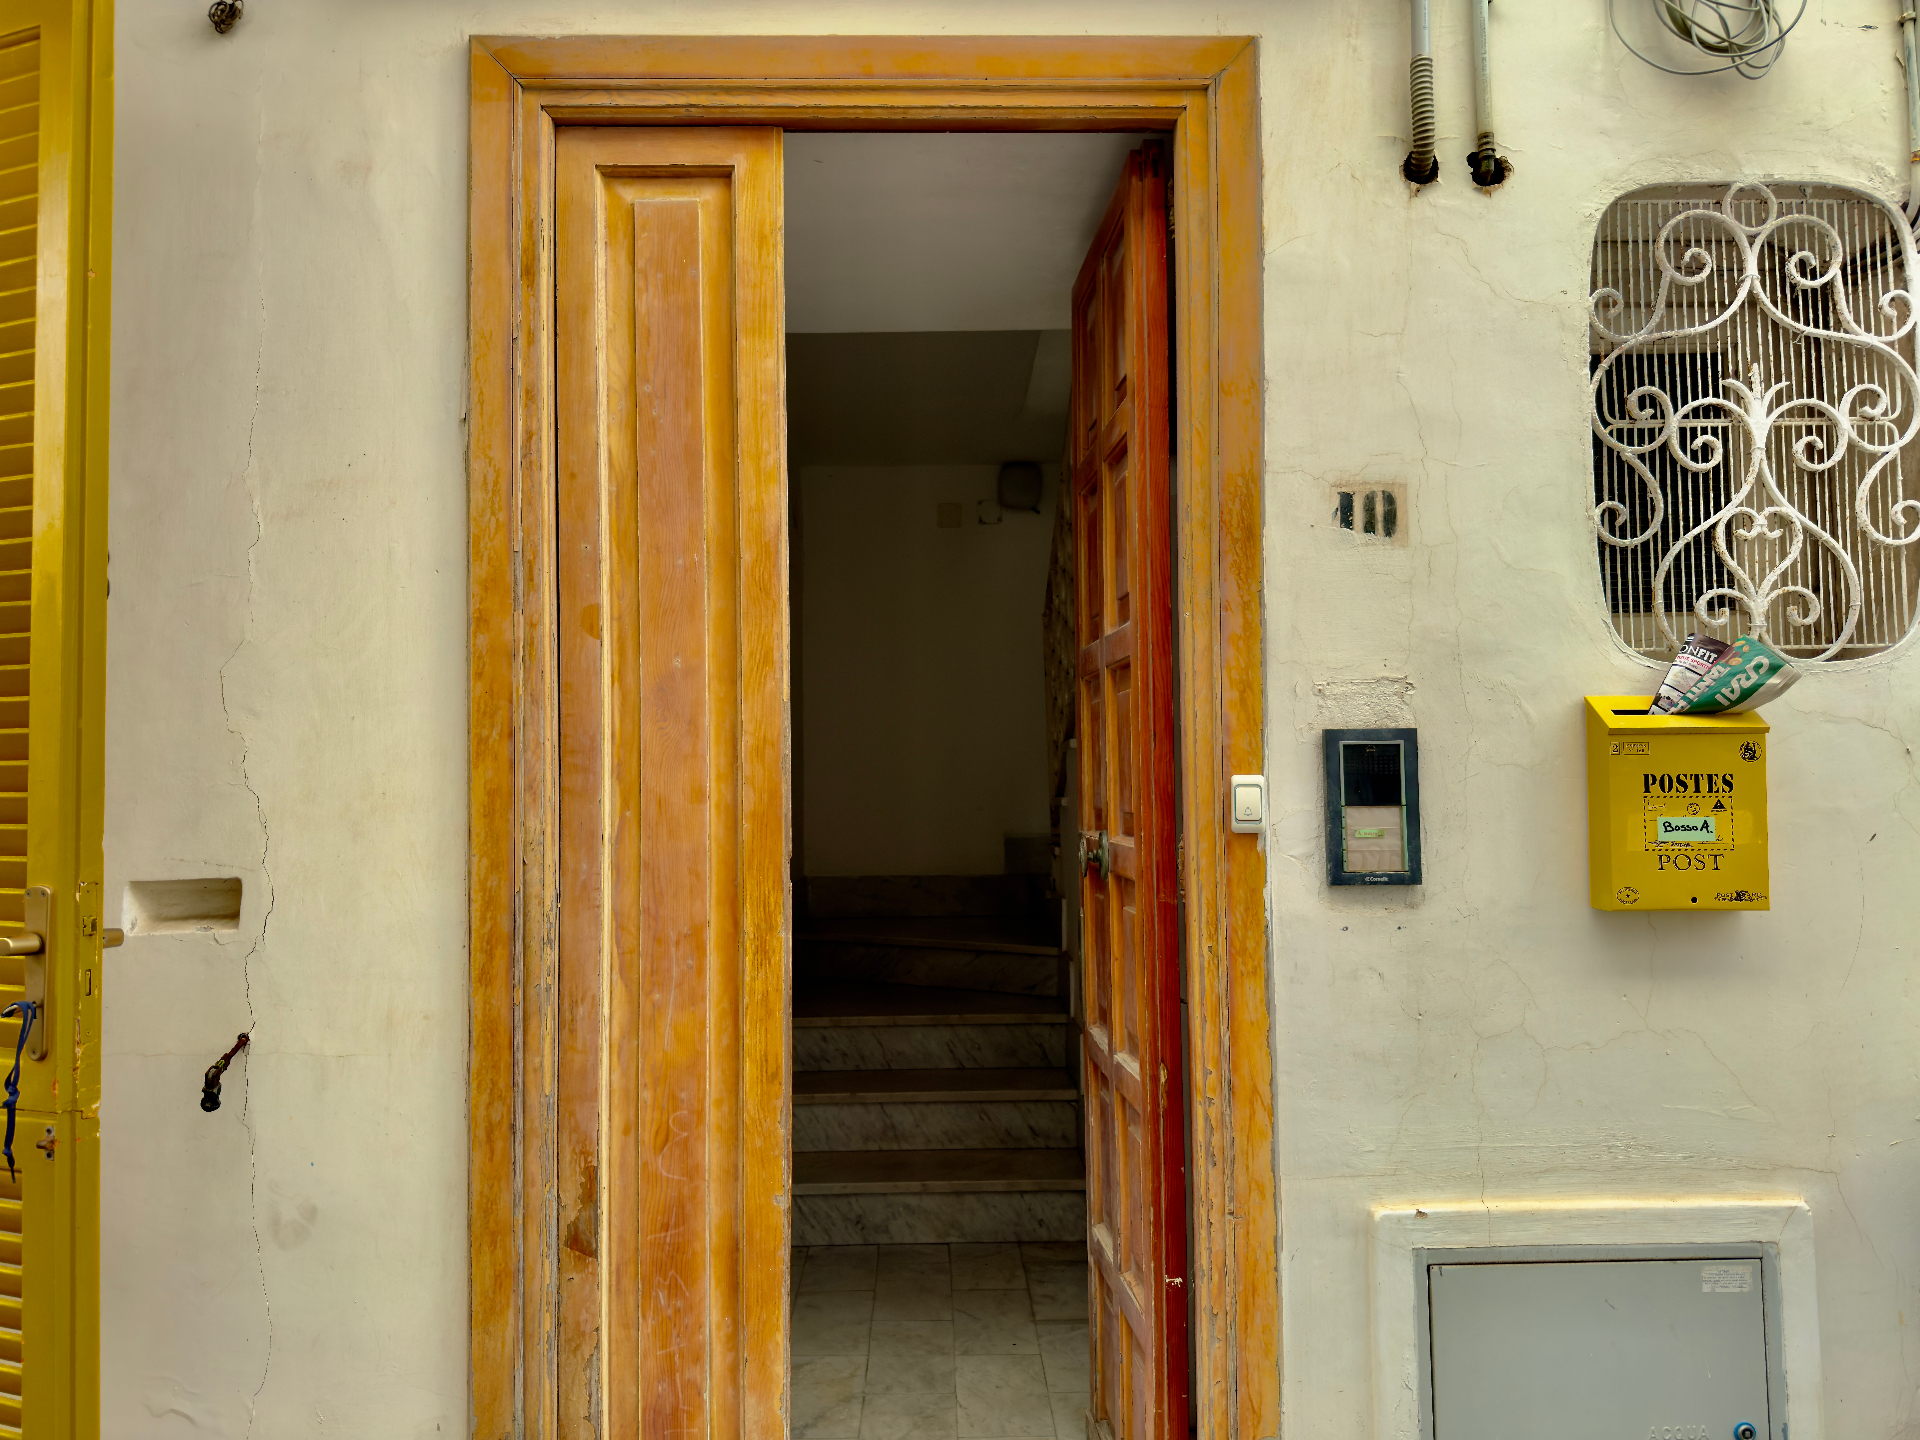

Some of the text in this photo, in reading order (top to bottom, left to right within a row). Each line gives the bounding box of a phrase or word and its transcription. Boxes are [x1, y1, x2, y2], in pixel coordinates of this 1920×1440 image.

[1715, 655, 1770, 706] CRAI
[1642, 773, 1734, 794] POSTES
[1662, 821, 1699, 833] Bosso
[1657, 853, 1725, 871] POST
[1647, 1425, 1710, 1440] ACQUA
